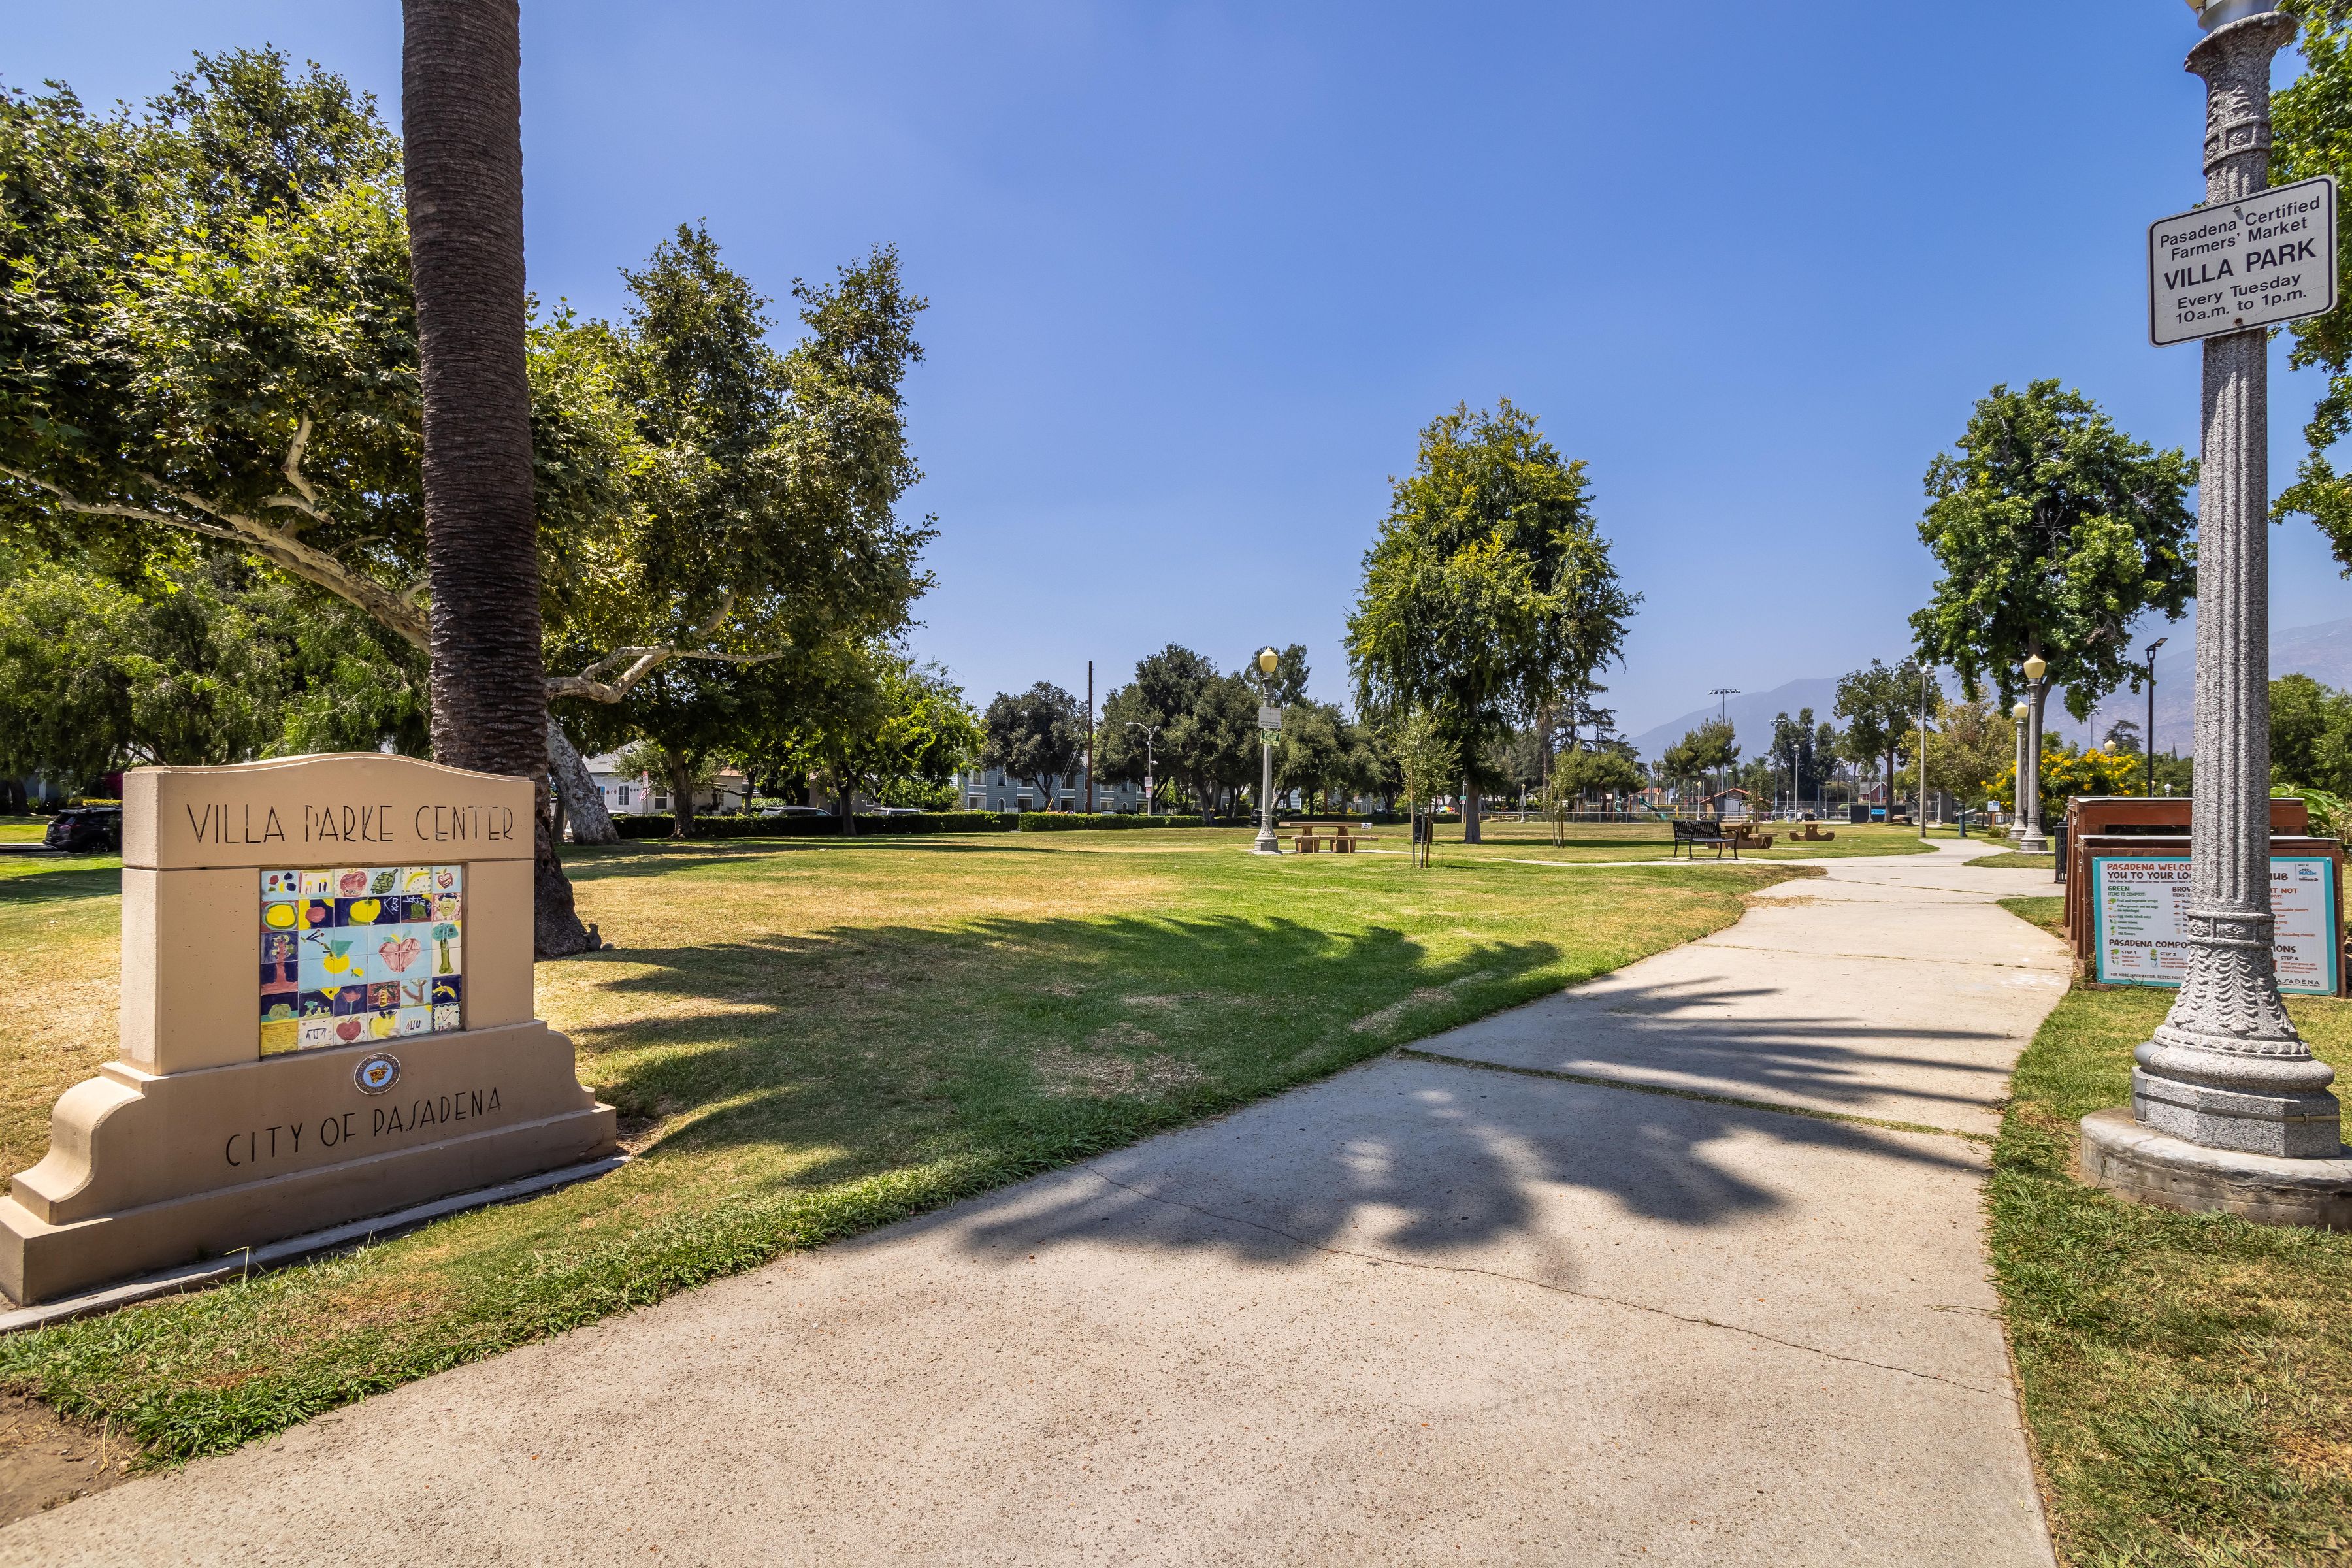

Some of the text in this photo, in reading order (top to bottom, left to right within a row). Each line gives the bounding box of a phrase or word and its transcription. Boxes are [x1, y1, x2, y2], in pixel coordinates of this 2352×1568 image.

[2160, 195, 2320, 248] Pasadena Certified
[2248, 216, 2308, 242] Market
[2163, 237, 2317, 291] VILLA PARK
[2175, 289, 2307, 324] 10a.m. to 1p.m.
[2178, 274, 2302, 310] Every Tuesday
[186, 804, 514, 844] VILLA PARKE CENTER
[2109, 939, 2153, 948] PASADENA
[2155, 940, 2189, 949] COMPO
[225, 1086, 502, 1166] CITY OF PASADENA
